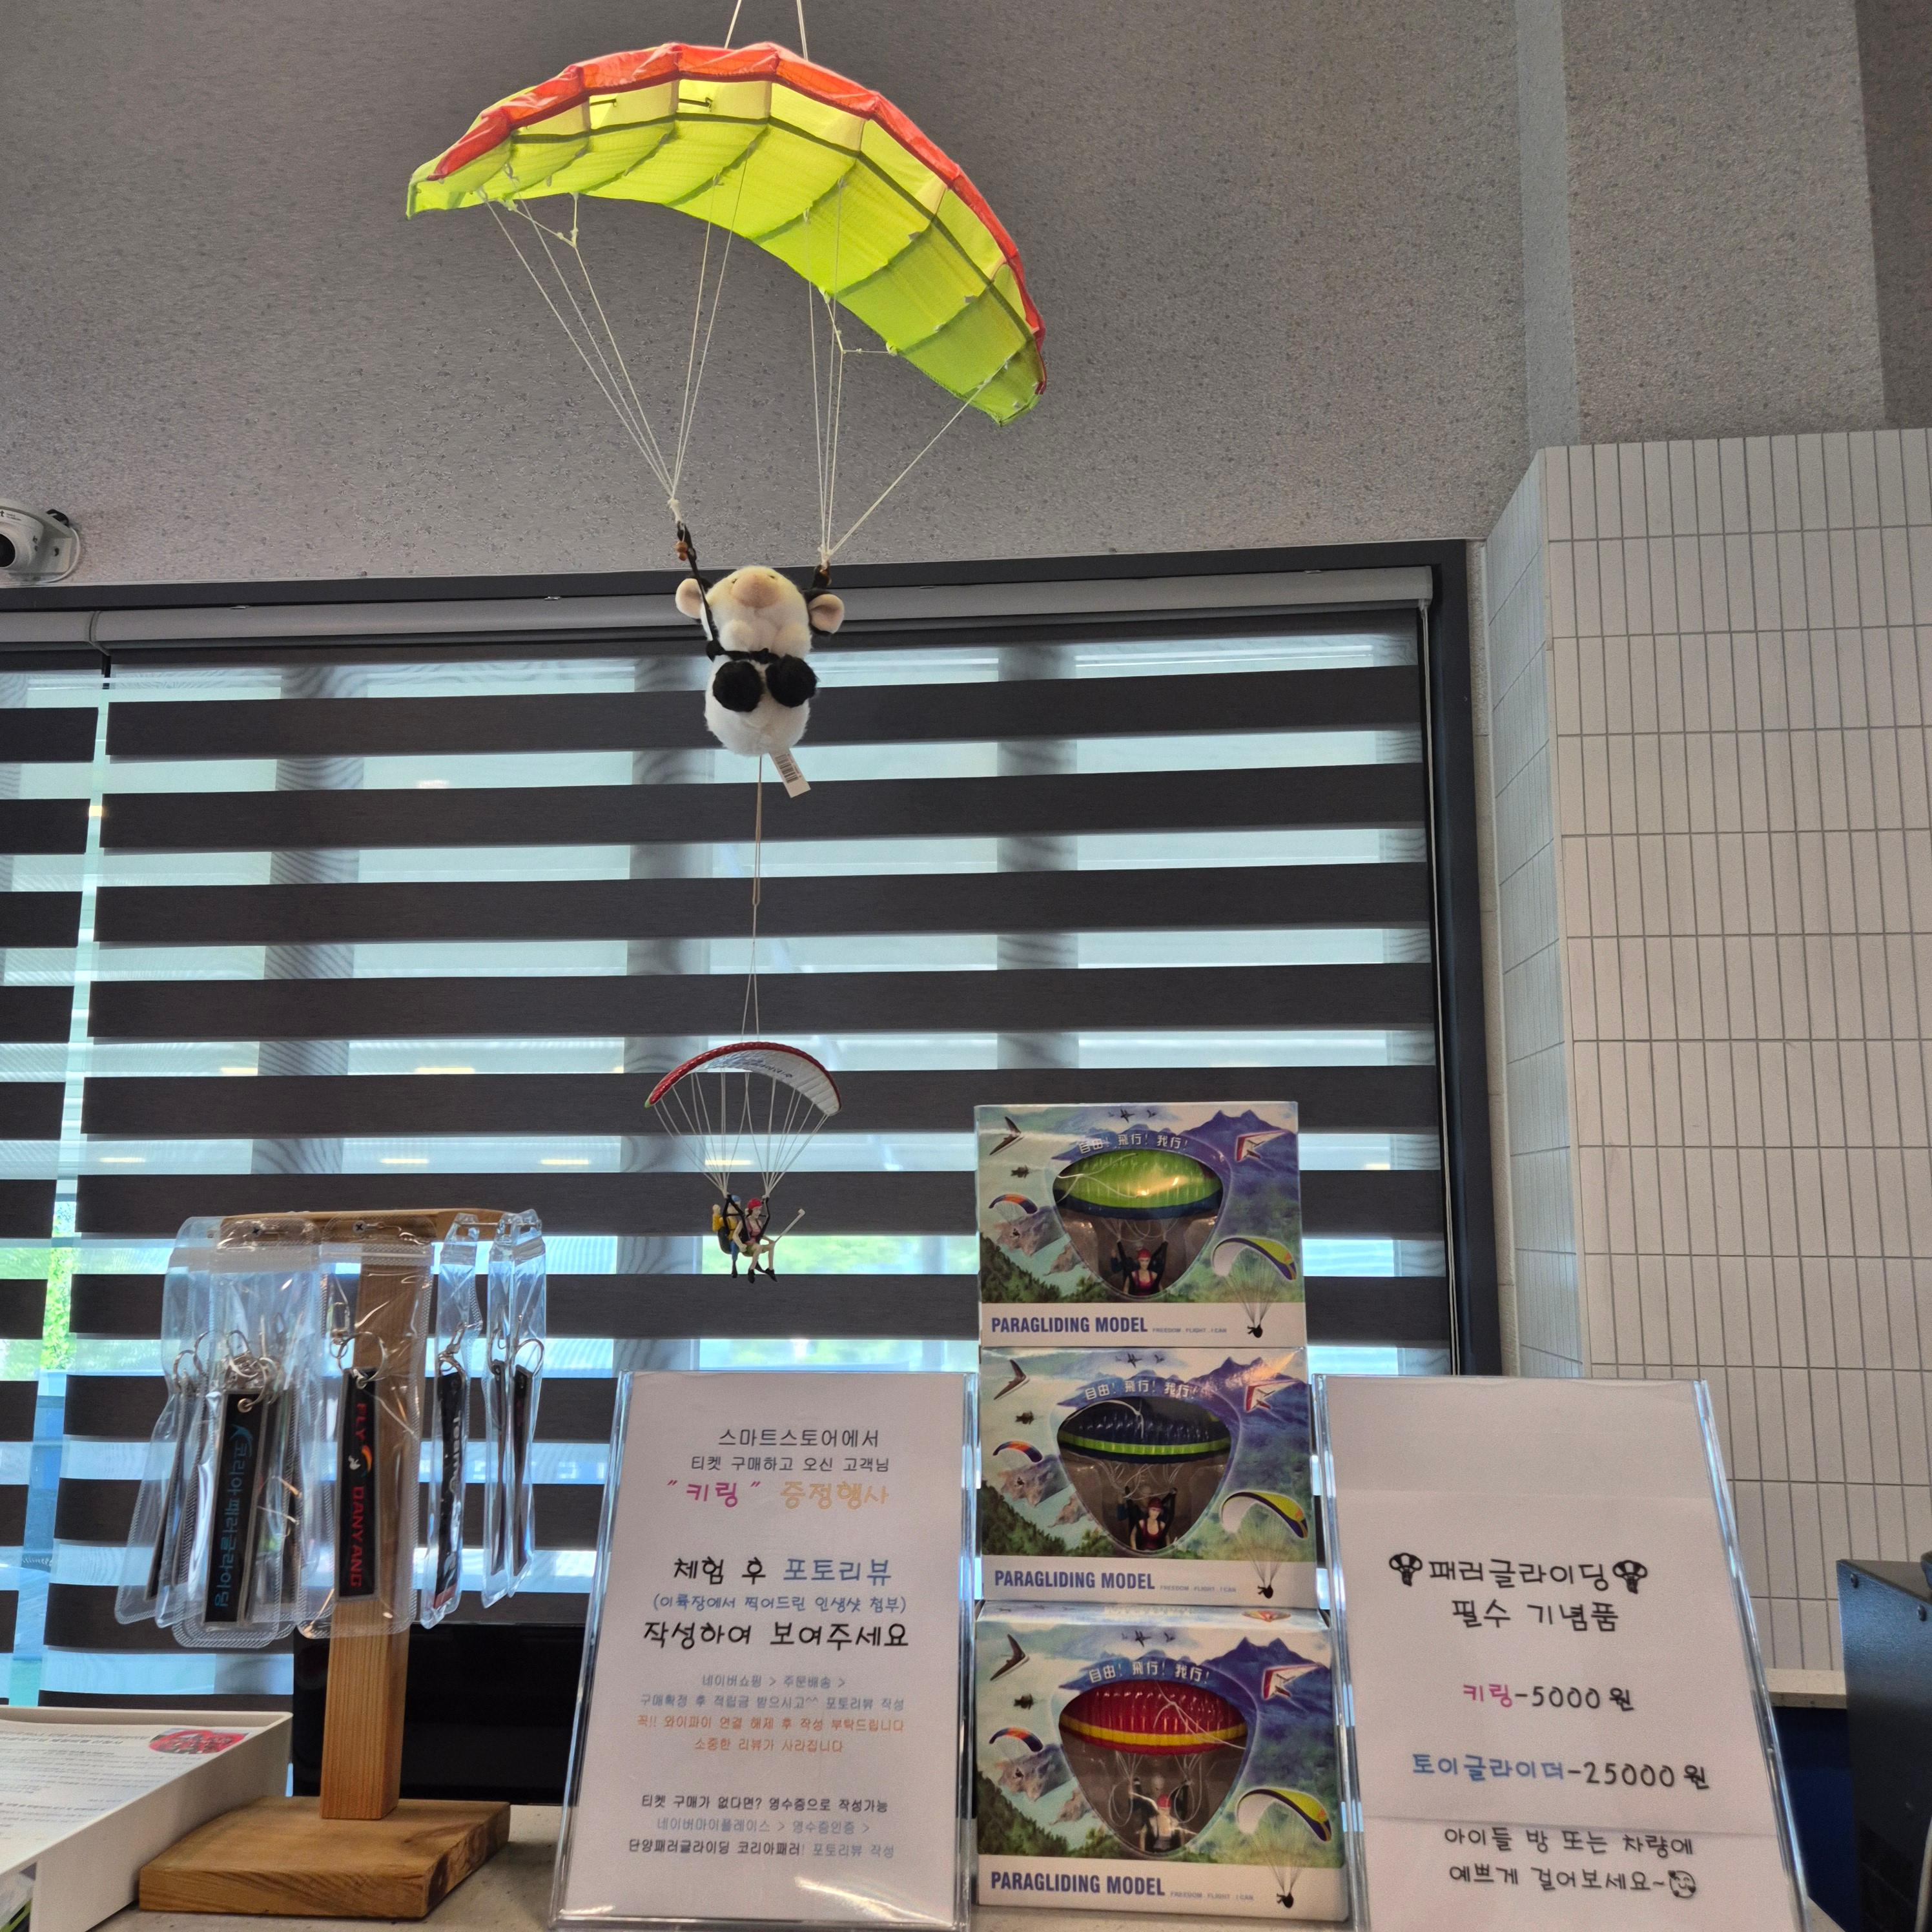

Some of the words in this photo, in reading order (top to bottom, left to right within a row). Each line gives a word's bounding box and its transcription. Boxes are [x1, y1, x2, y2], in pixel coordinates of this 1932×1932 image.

[991, 1317, 1090, 1333] PARAGLIDING
[1094, 1317, 1148, 1333] MODEL
[356, 1403, 367, 1439] FLY
[718, 1428, 879, 1448] 스마트스토어에서
[691, 1455, 721, 1471] 티켓
[731, 1456, 794, 1472] 구매하고
[802, 1457, 833, 1472] 오신
[843, 1457, 889, 1473] 고객님
[779, 1481, 890, 1511] 증정행사
[351, 1486, 364, 1587] DANYANG
[673, 1556, 724, 1585] 체험
[741, 1556, 766, 1585] 후
[783, 1558, 892, 1587] 포토리뷰
[994, 1570, 1096, 1588] PARAGLIDING
[1101, 1572, 1156, 1590] MODEL
[1429, 1560, 1608, 1590] 패러글라이딩
[653, 1593, 736, 1612] (이륙장에서
[744, 1596, 806, 1612] 찍어드린
[814, 1596, 861, 1614] 인생샷
[869, 1596, 907, 1614] 첨부)
[1451, 1598, 1512, 1629] 필수
[1526, 1601, 1619, 1632] 기념품
[643, 1621, 752, 1650] 작성하여
[770, 1621, 909, 1652] 보여주세요
[826, 1696, 874, 1711] 포토리뷰
[881, 1697, 905, 1712] 작성
[663, 1715, 712, 1729] 와이파이
[719, 1716, 743, 1731] 연결
[750, 1716, 774, 1730] 해제
[799, 1717, 824, 1732] 작성
[831, 1718, 905, 1733] 부탁드립니다
[694, 1737, 731, 1752] 소중한
[738, 1738, 774, 1752] 리뷰가
[781, 1739, 844, 1753] 사라집니다
[641, 1794, 666, 1808] 티켓
[673, 1795, 710, 1809] 구매가
[717, 1796, 763, 1810] 없다면?
[768, 1797, 831, 1812] 영수증으로
[838, 1798, 889, 1814] 작성가능
[628, 1838, 730, 1855] 단양패러글라이딩
[812, 1843, 863, 1858] 포토리뷰
[870, 1844, 894, 1860] 작성
[1444, 1826, 1512, 1853] 아이들
[1525, 1829, 1549, 1855] 방
[1561, 1828, 1608, 1855] 또는
[1622, 1833, 1694, 1860] 차량에
[991, 1871, 1100, 1893] PARAGLIDING
[1106, 1875, 1166, 1896] MODEL
[1448, 1863, 1519, 1886] 예쁘게
